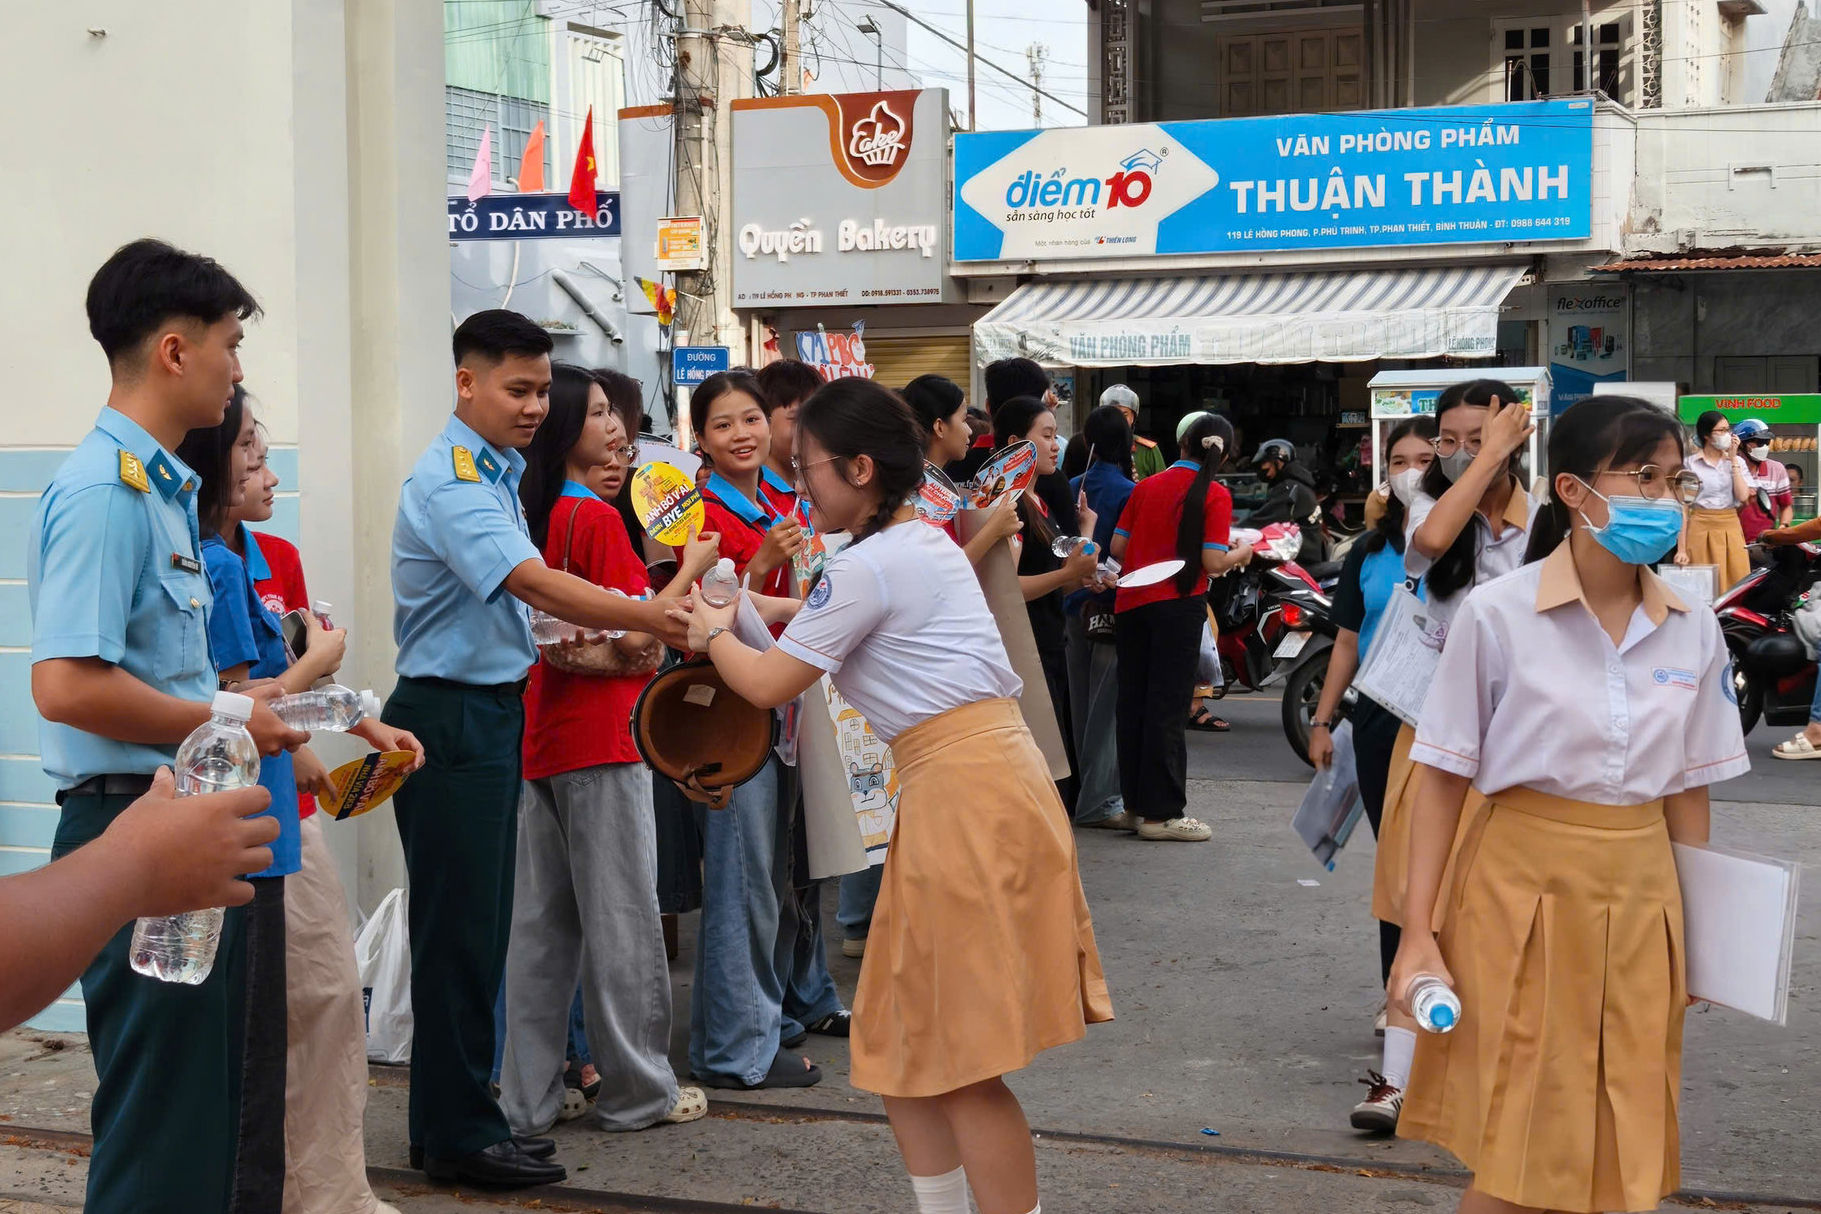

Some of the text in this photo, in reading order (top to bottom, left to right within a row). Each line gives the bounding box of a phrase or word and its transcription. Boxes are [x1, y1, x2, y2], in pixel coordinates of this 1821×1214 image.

[1275, 117, 1520, 158] VĂN PHÒNG PHẨM
[1105, 171, 1153, 210] 10
[1229, 158, 1569, 219] THUẬN THÀNH
[448, 199, 613, 232] TỔ DÂN PHỐ
[1006, 207, 1096, 222] sẵn sàng học tốt
[1227, 231, 1242, 239] 119
[1370, 224, 1405, 234] TP.PHAN
[1436, 219, 1456, 231] BÌNH
[1535, 217, 1551, 227] 644
[1554, 216, 1571, 226] 319
[738, 218, 822, 262] Quyền
[838, 219, 937, 258] Bakery
[1069, 331, 1097, 359] VĂN
[1101, 329, 1146, 358] PHÒNG
[1150, 325, 1191, 357] PHẨM
[686, 351, 717, 362] ĐƯỜNG
[686, 364, 705, 380] HỒNG
[1715, 398, 1782, 409] VINH FOOD
[645, 502, 665, 524] ANH
[662, 505, 684, 528] BYE
